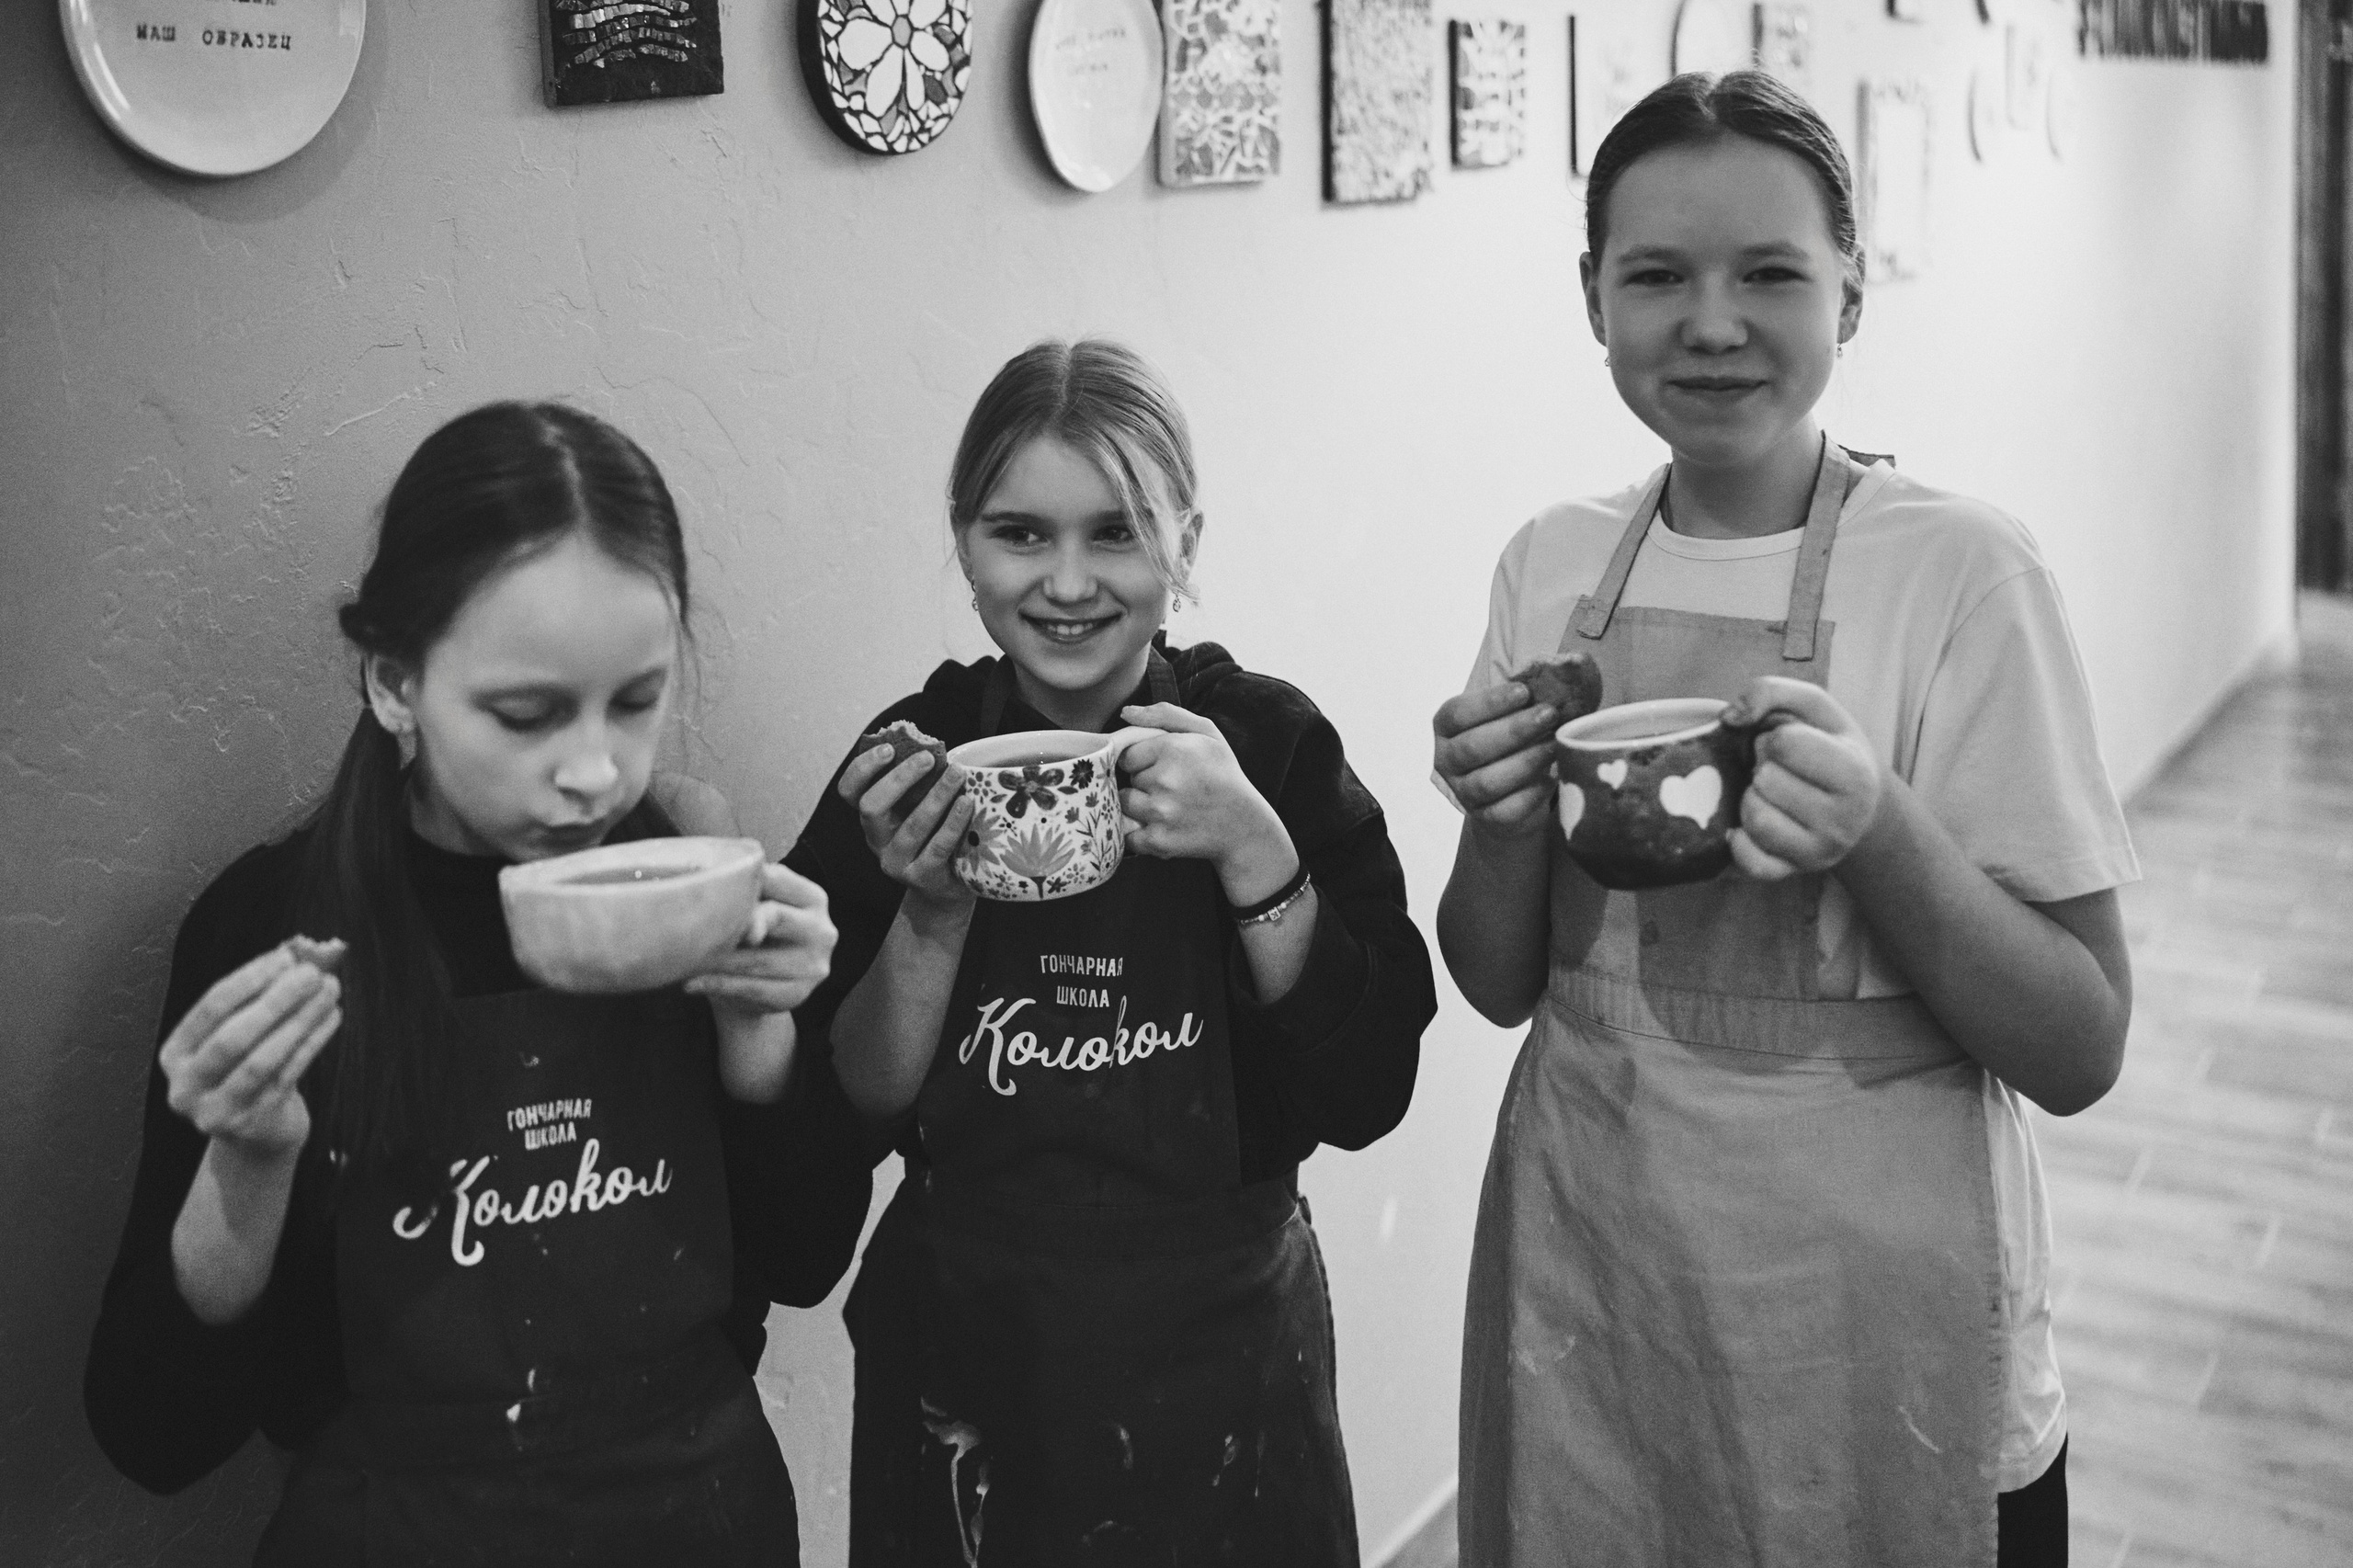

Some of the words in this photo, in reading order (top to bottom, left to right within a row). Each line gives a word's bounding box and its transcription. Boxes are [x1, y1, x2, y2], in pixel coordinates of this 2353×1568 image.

[201, 28, 291, 51] ОБРАЗЕЦ
[1040, 953, 1124, 977] ГОНЧАРНАЯ
[1056, 984, 1110, 1008] ШКОЛА
[506, 1098, 592, 1131] ГОНЧАРНАЯ
[524, 1120, 577, 1151] ШКОЛА
